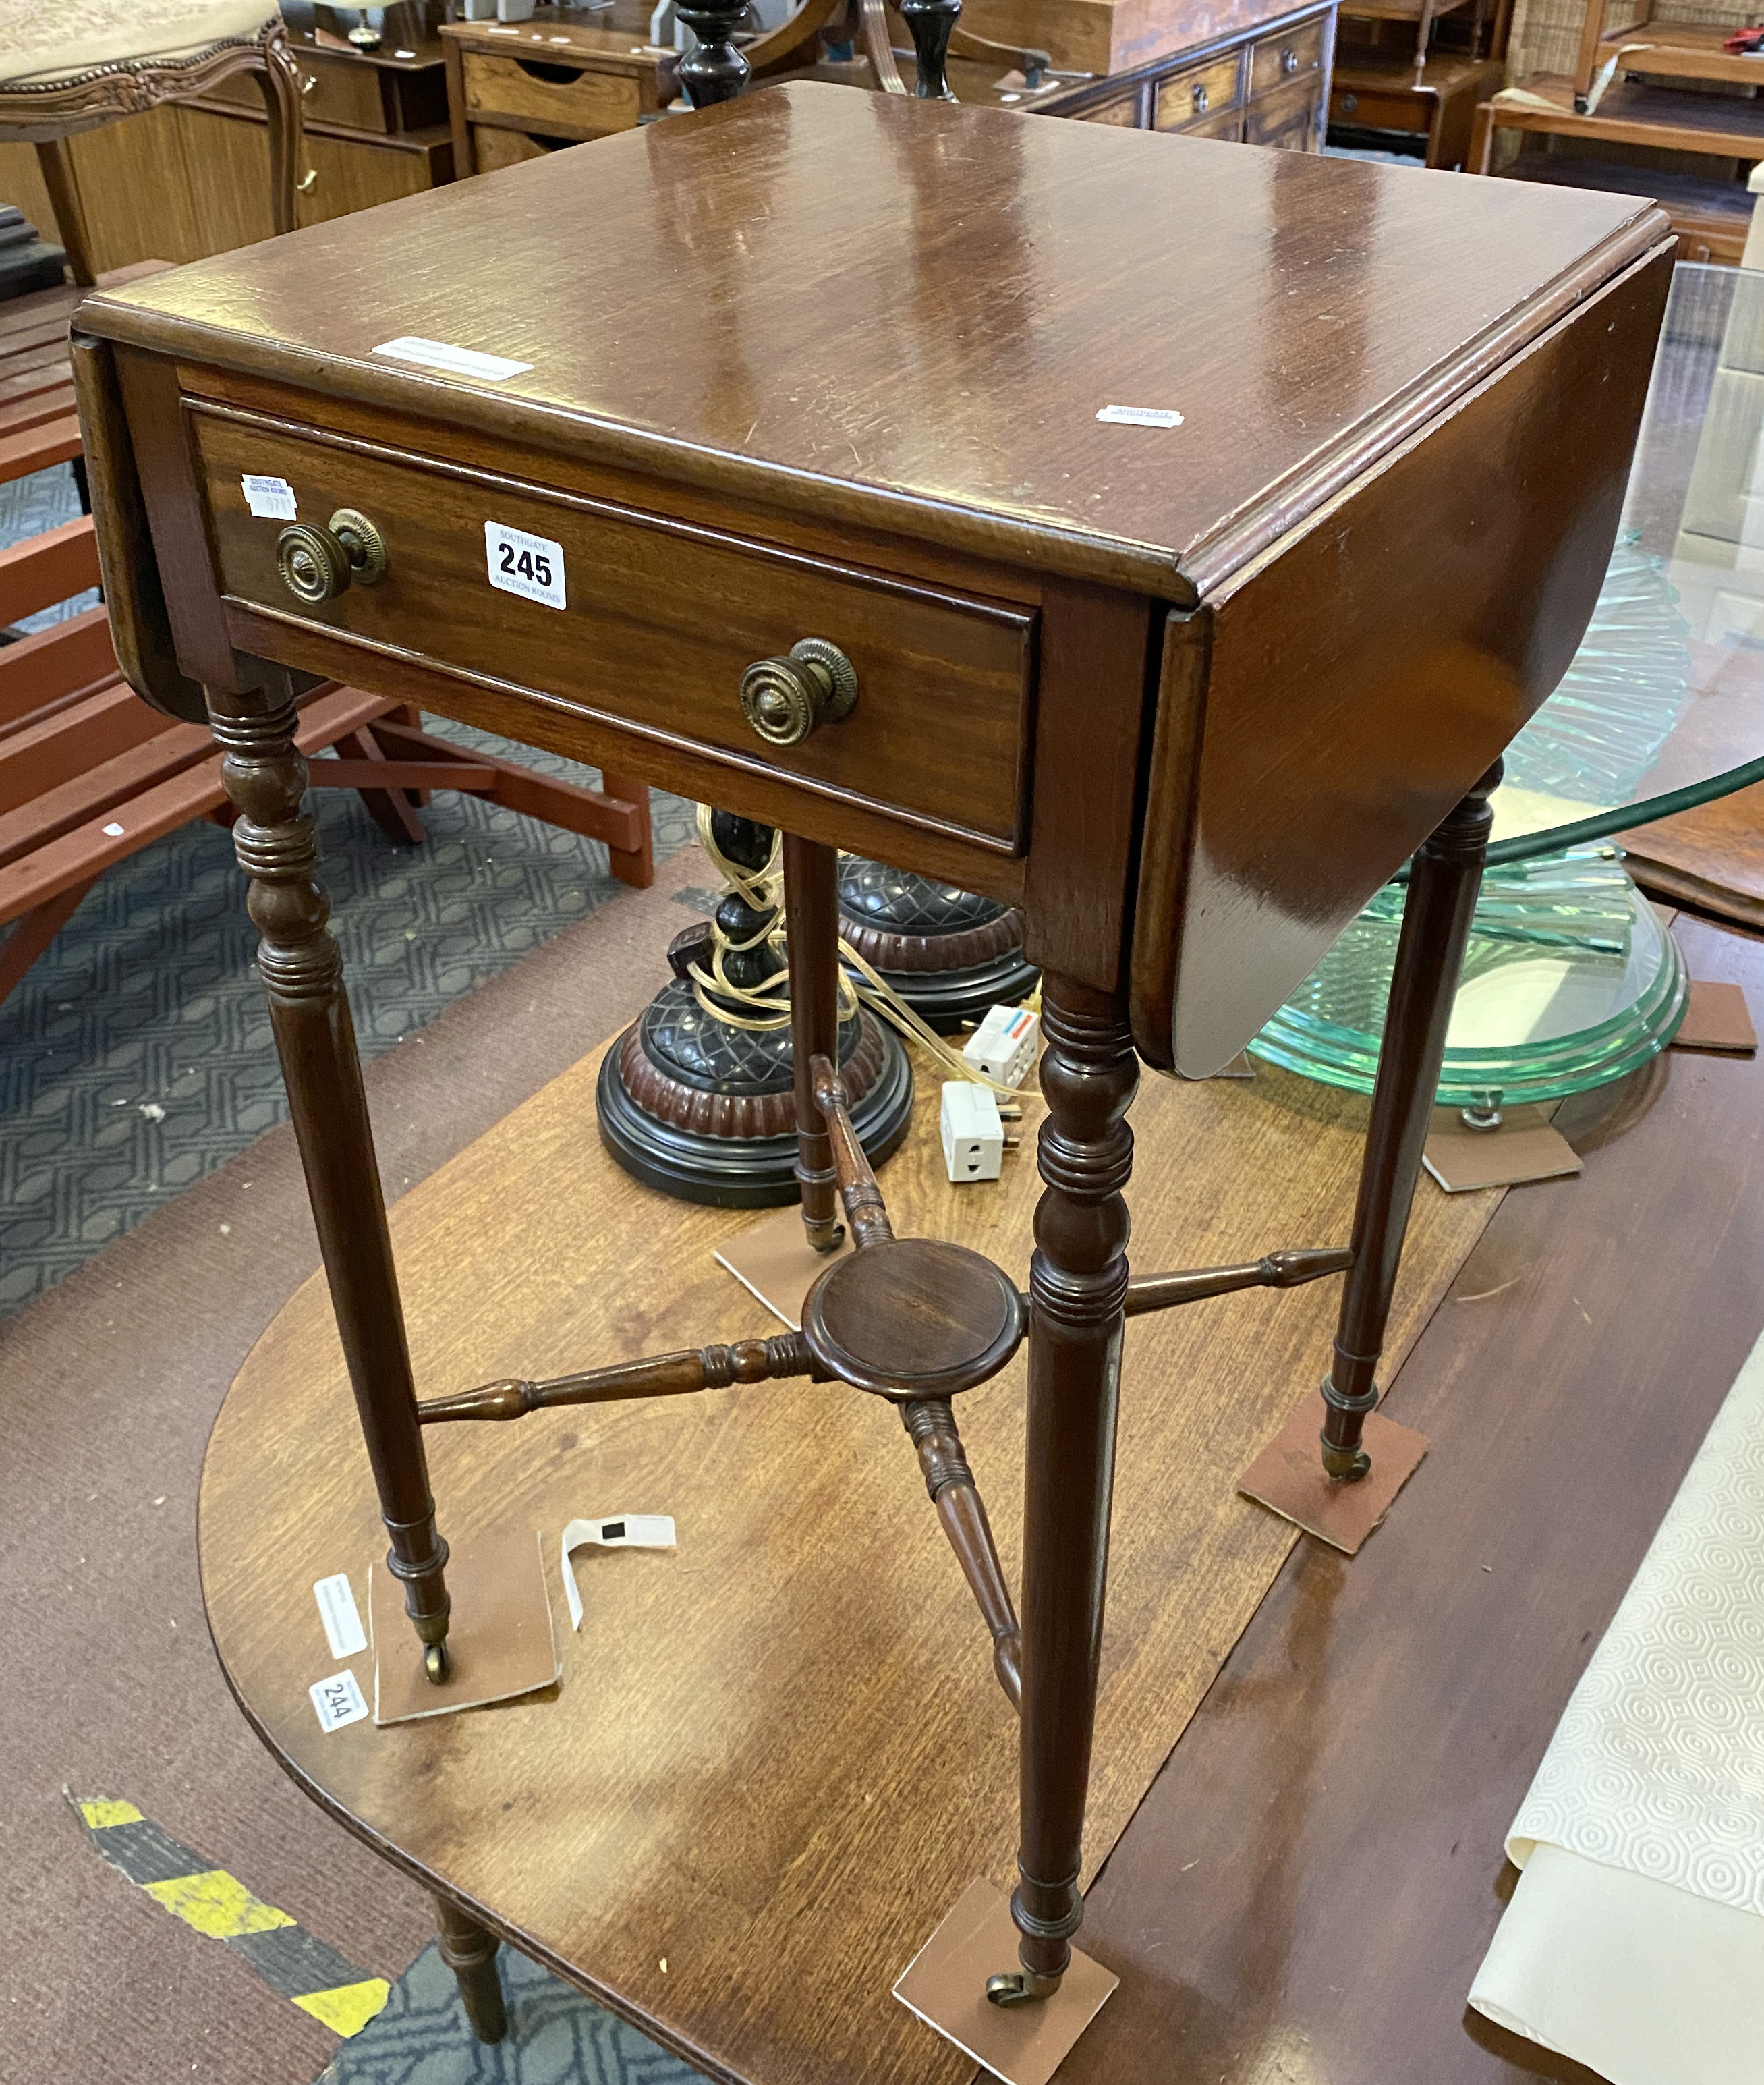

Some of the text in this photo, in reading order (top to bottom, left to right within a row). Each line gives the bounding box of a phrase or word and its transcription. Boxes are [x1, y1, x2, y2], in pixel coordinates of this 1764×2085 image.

[500, 530, 548, 553] SOUTHGATE
[499, 543, 552, 587] 245
[494, 575, 561, 603] AUCTION ROOMS
[324, 1683, 352, 1719] 244
